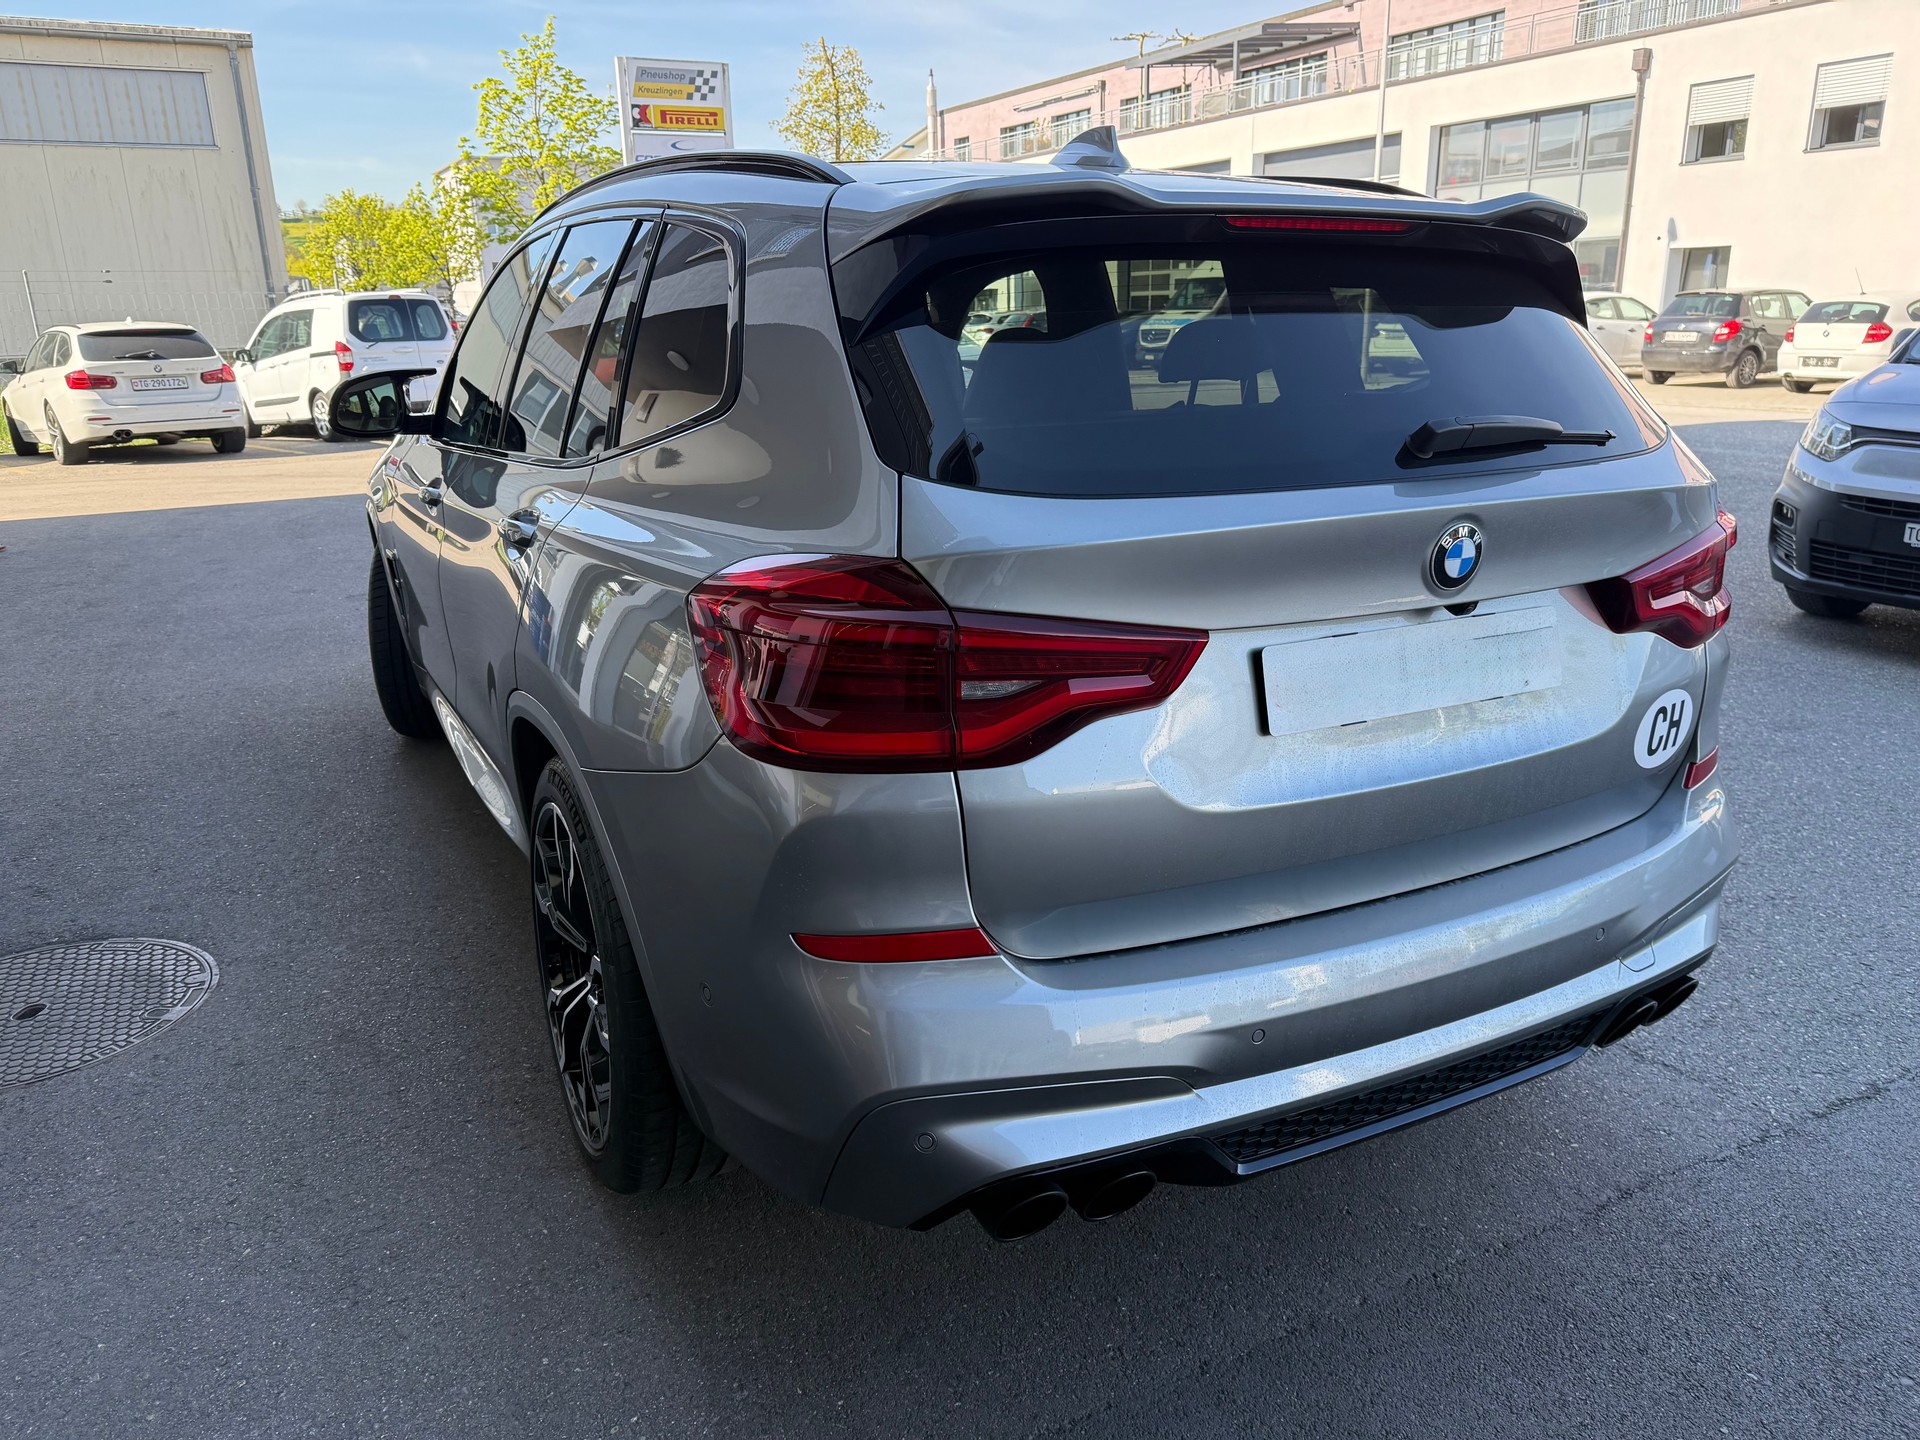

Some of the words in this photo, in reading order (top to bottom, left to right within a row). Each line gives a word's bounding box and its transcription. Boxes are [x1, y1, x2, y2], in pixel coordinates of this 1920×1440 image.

[640, 69, 686, 82] Pneushop
[637, 85, 683, 97] Kreuzlingen
[660, 109, 718, 126] PIRELLI
[1441, 526, 1481, 549] BMW
[1647, 699, 1685, 756] CH
[552, 773, 585, 838] MICHELIN
